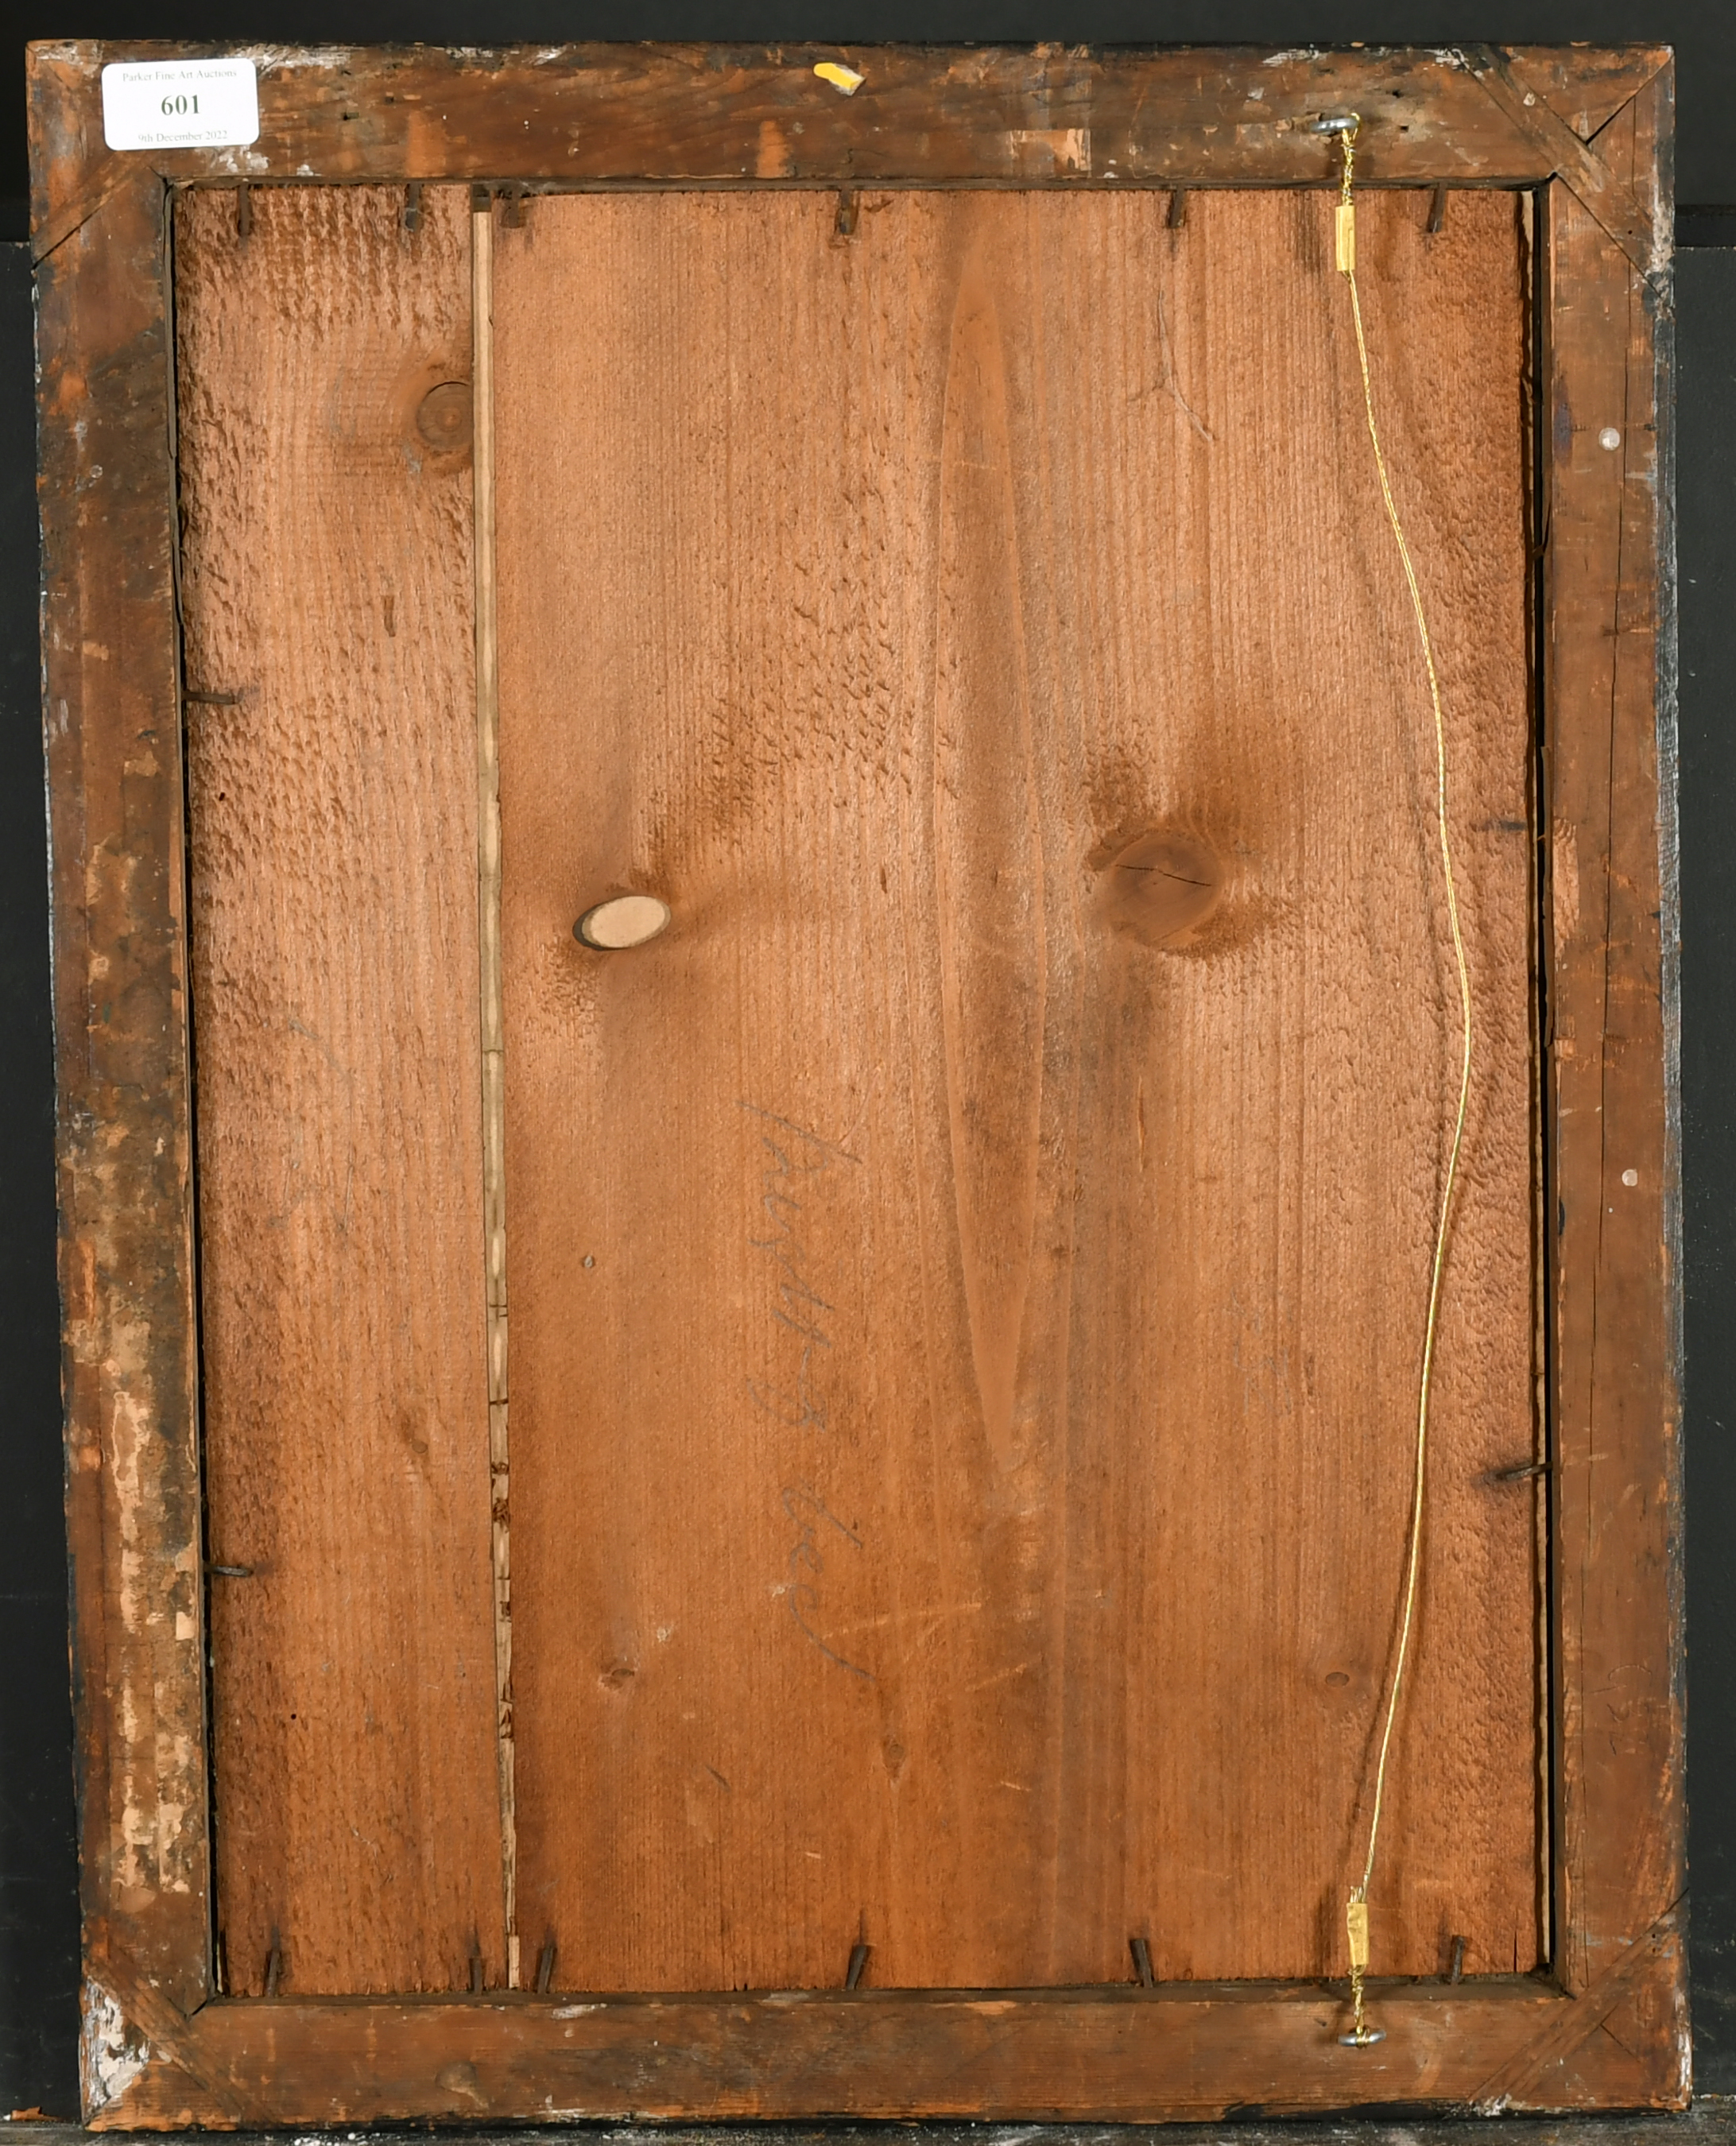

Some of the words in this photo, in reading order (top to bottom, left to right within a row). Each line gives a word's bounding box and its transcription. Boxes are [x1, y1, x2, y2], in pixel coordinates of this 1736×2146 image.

[123, 72, 152, 82] Parker
[156, 71, 175, 80] Fine
[196, 70, 237, 79] Auctions
[161, 95, 200, 115] 601
[157, 132, 202, 142] December
[205, 130, 227, 140] 2022
